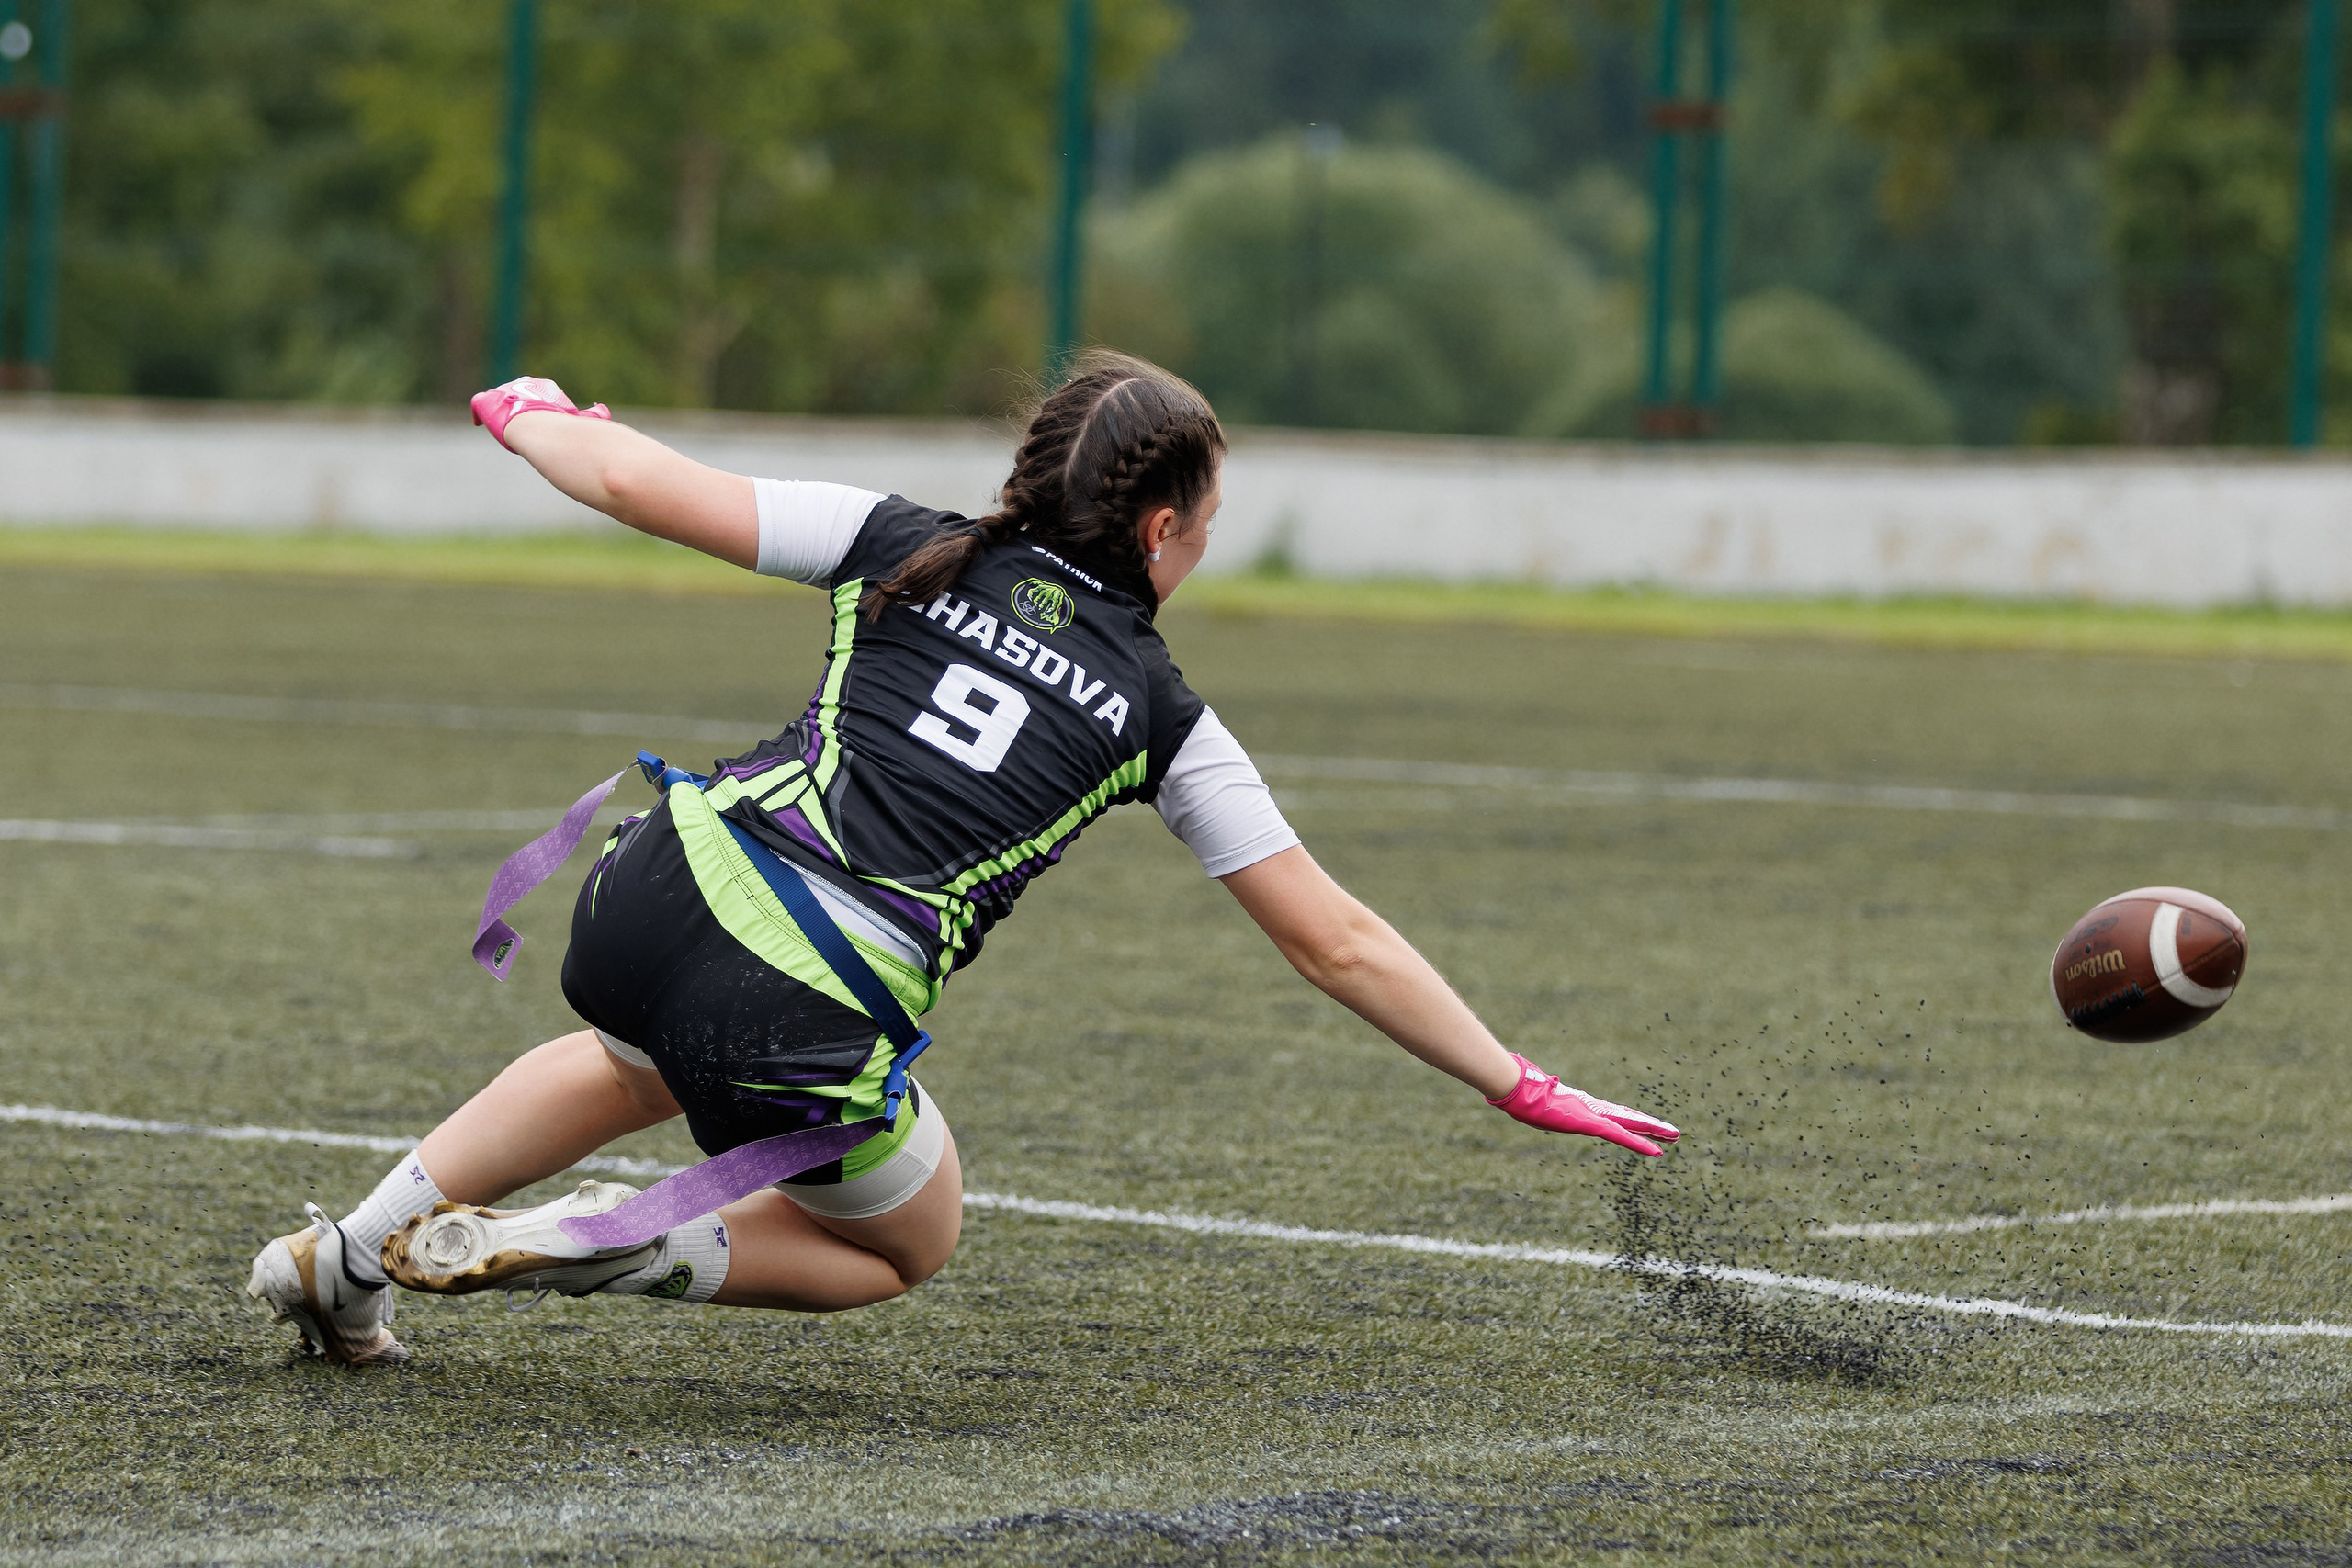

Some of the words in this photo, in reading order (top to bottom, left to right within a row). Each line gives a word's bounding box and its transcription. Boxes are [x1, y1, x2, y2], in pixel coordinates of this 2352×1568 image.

[898, 590, 1131, 738] HASOVA
[907, 663, 1032, 773] 9
[2064, 949, 2127, 982] Wilson
